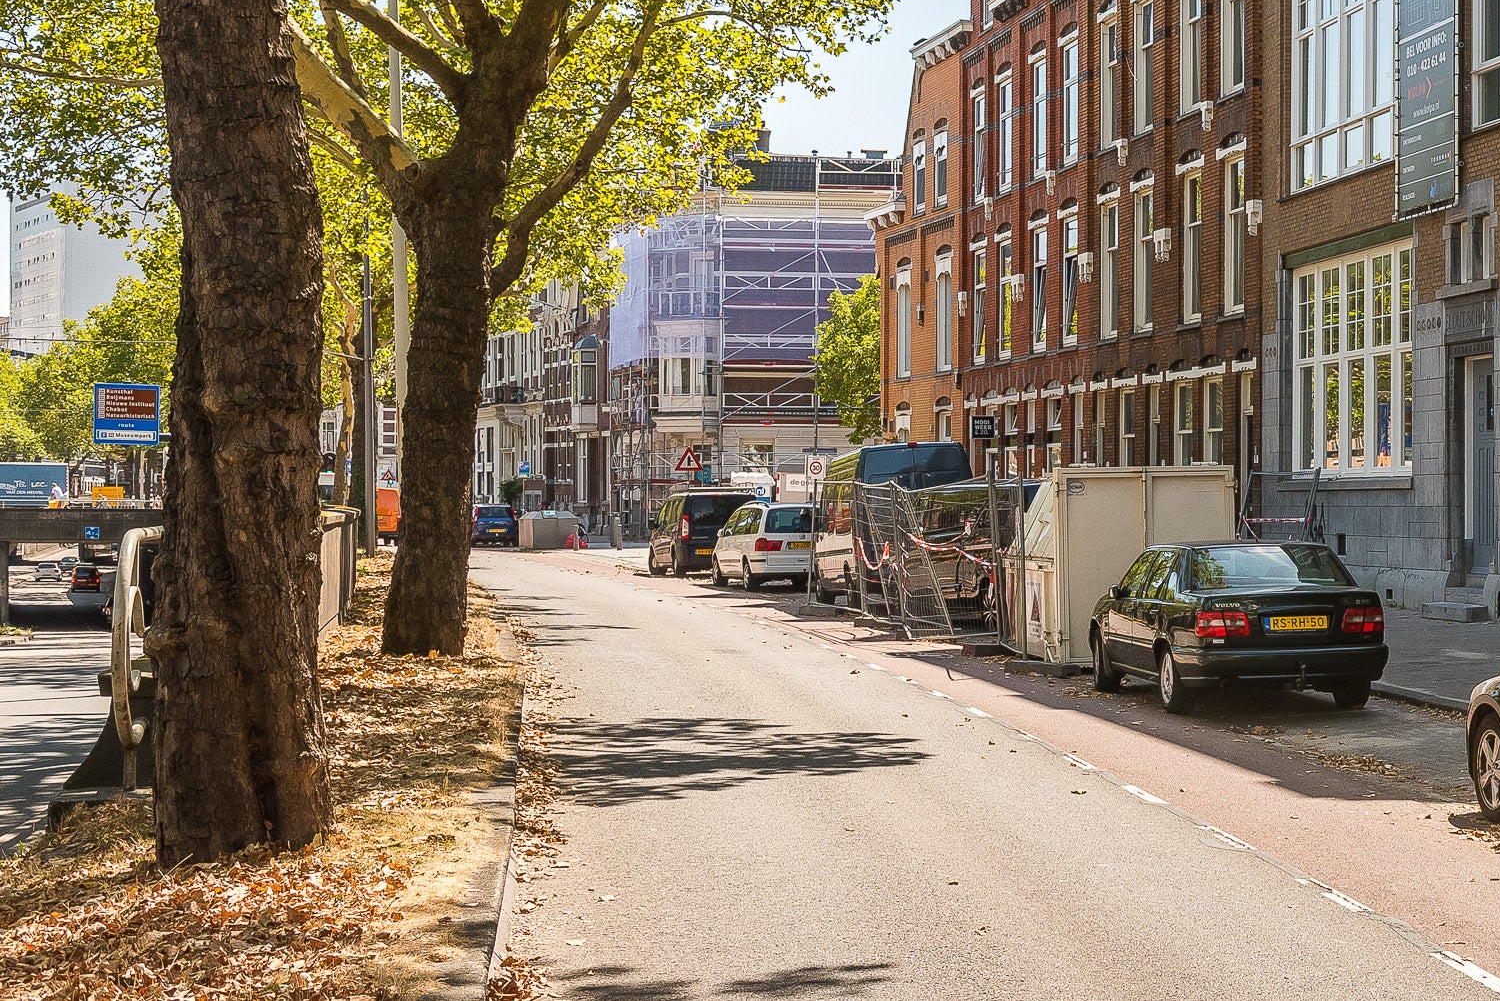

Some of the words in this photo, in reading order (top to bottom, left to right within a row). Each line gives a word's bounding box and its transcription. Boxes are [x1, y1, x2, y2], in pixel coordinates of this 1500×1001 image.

[1406, 44, 1416, 59] BEL
[1415, 37, 1432, 55] VOOR
[1431, 30, 1447, 48] INFO:
[1406, 63, 1418, 78] 010
[1420, 57, 1431, 72] 422
[1431, 53, 1439, 68] 61
[1439, 50, 1447, 64] 44
[811, 463, 821, 472] 30
[1272, 616, 1325, 629] RS-RH-50
